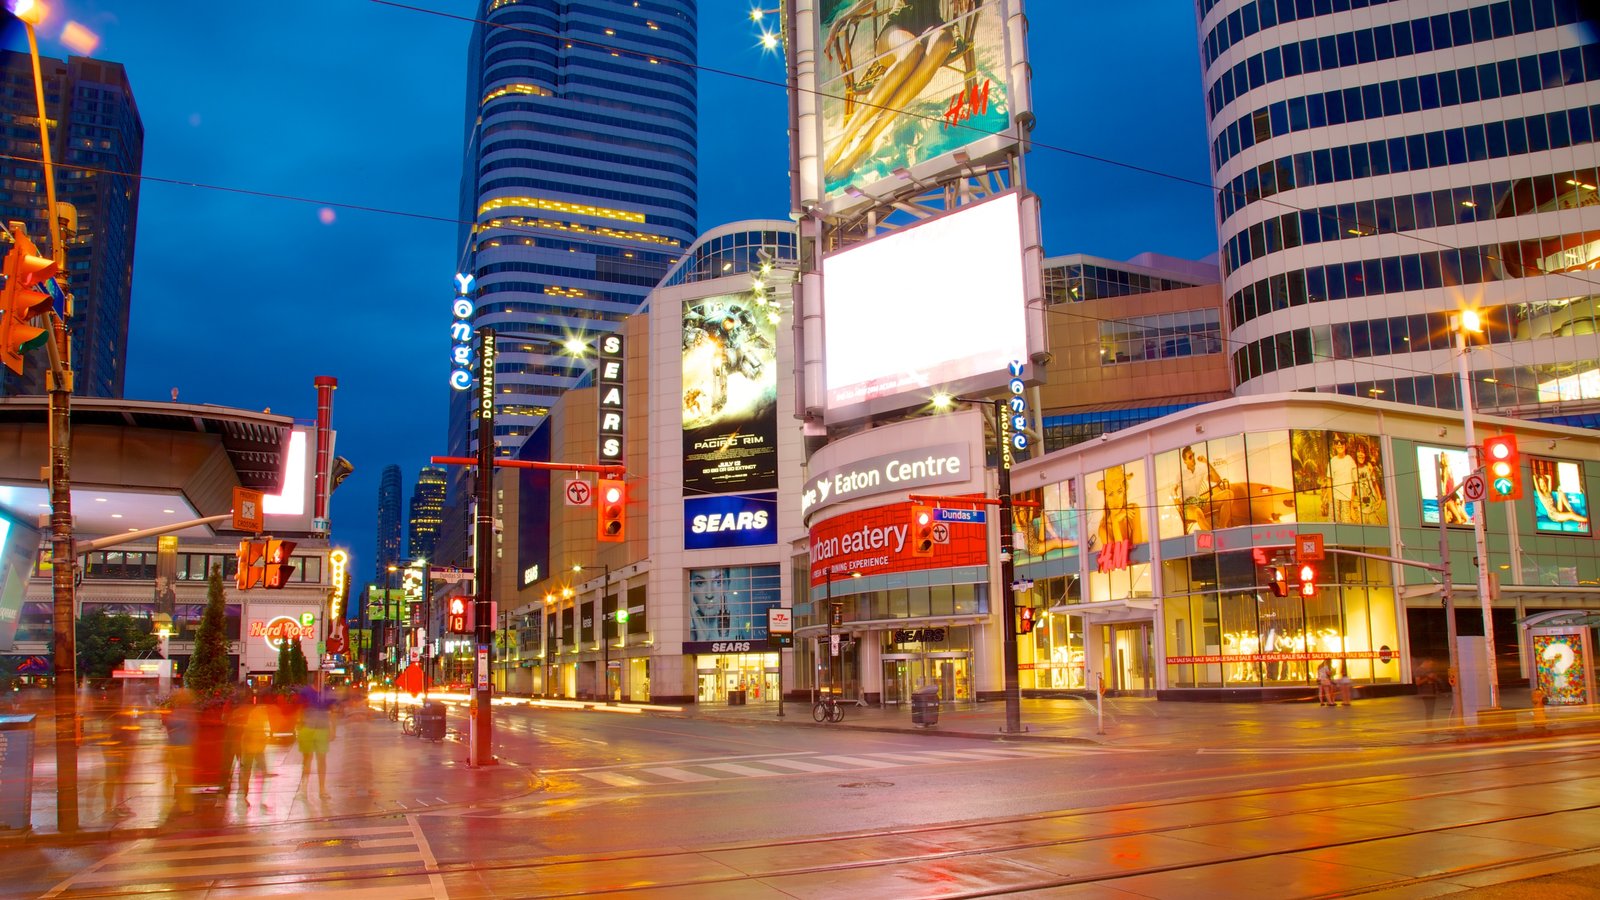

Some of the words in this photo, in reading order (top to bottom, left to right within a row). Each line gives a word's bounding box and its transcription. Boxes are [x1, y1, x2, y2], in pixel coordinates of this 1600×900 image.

[944, 79, 990, 129] H&M
[482, 336, 494, 419] DOWNTOWN
[603, 336, 620, 457] SEARS
[694, 438, 738, 450] PACIFIC
[743, 436, 764, 445] RIM
[1001, 405, 1010, 470] DOWNTOWN
[835, 469, 880, 495] Eaton
[886, 455, 960, 482] Centre
[691, 510, 769, 534] SEARS
[942, 510, 971, 520] Dundas
[841, 524, 908, 555] eatery
[849, 556, 889, 569] EXPERIENCE
[303, 612, 314, 626] P
[250, 622, 282, 637] Hard
[895, 628, 945, 643] SEARS
[711, 641, 751, 653] SEARS
